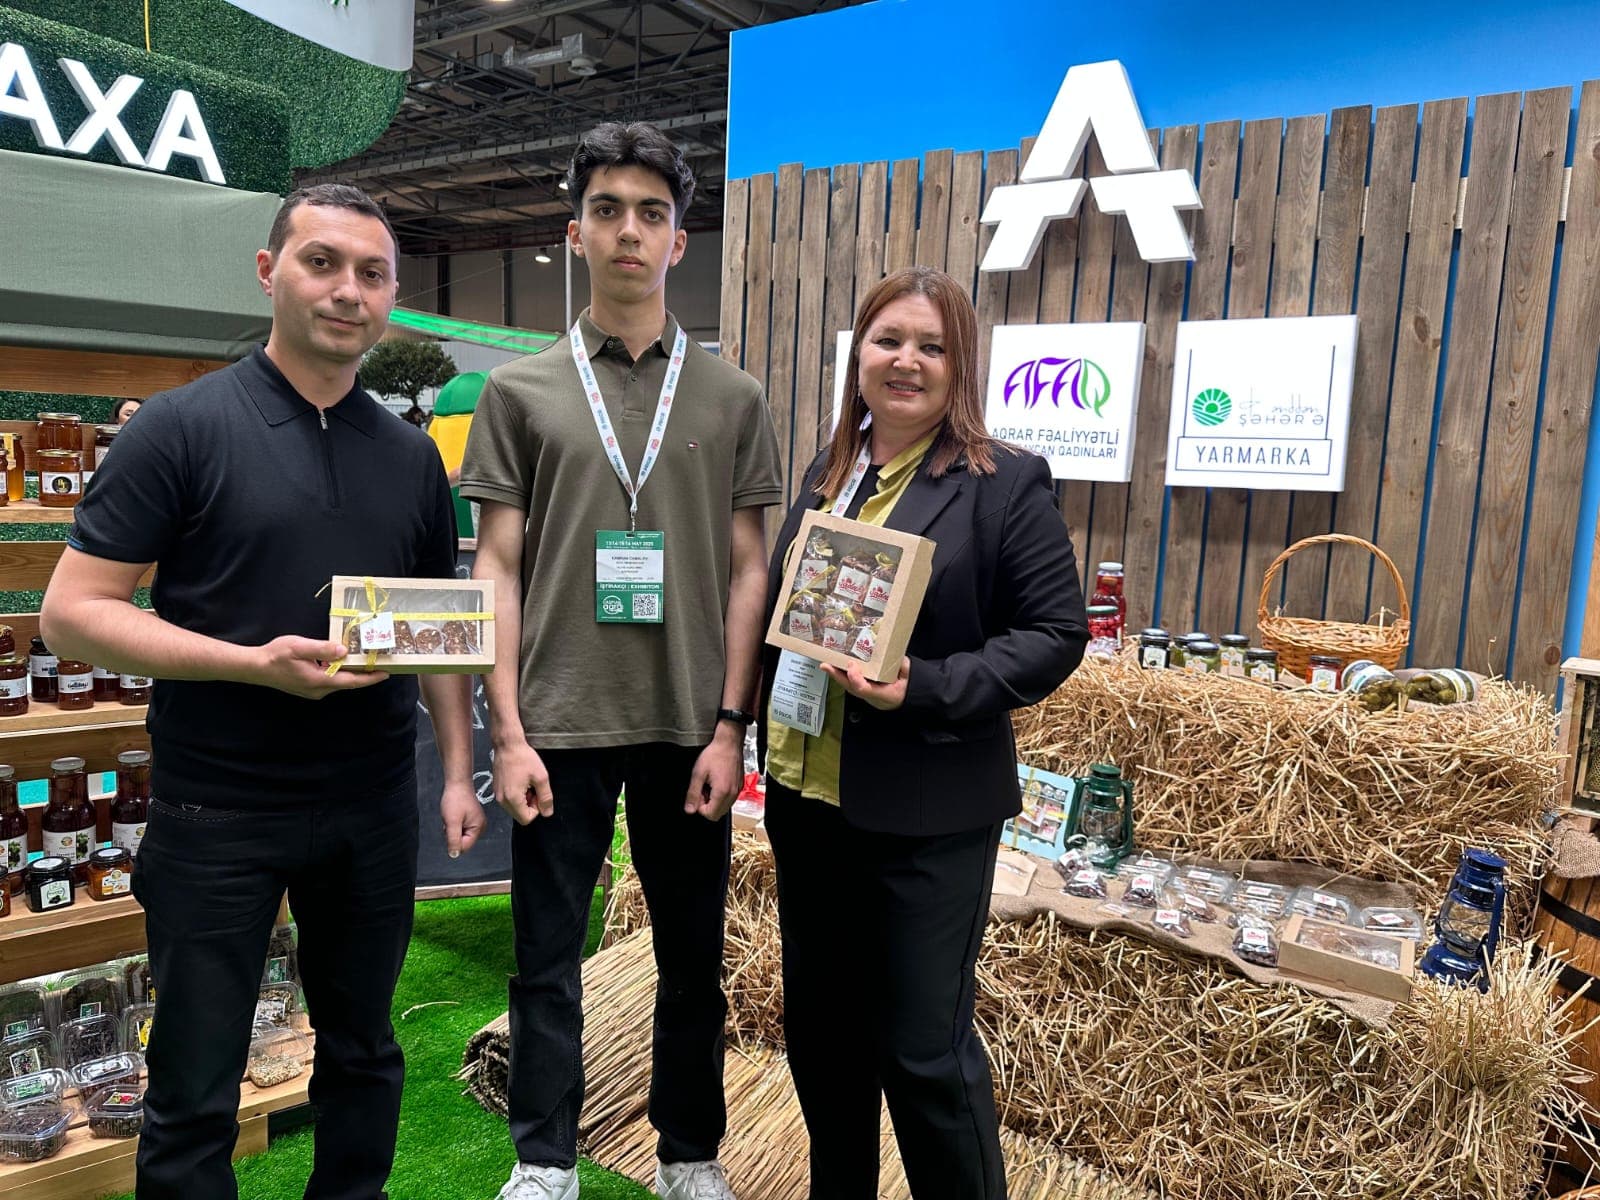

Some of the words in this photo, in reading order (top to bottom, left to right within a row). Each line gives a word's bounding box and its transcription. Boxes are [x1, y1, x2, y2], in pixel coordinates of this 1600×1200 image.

[1004, 357, 1111, 418] AFAQ
[992, 427, 1033, 441] AQRAR
[1038, 427, 1120, 445] FƏALİYYƏTLİ
[1058, 445, 1117, 459] QADINLARI
[1196, 445, 1311, 466] YARMARKA
